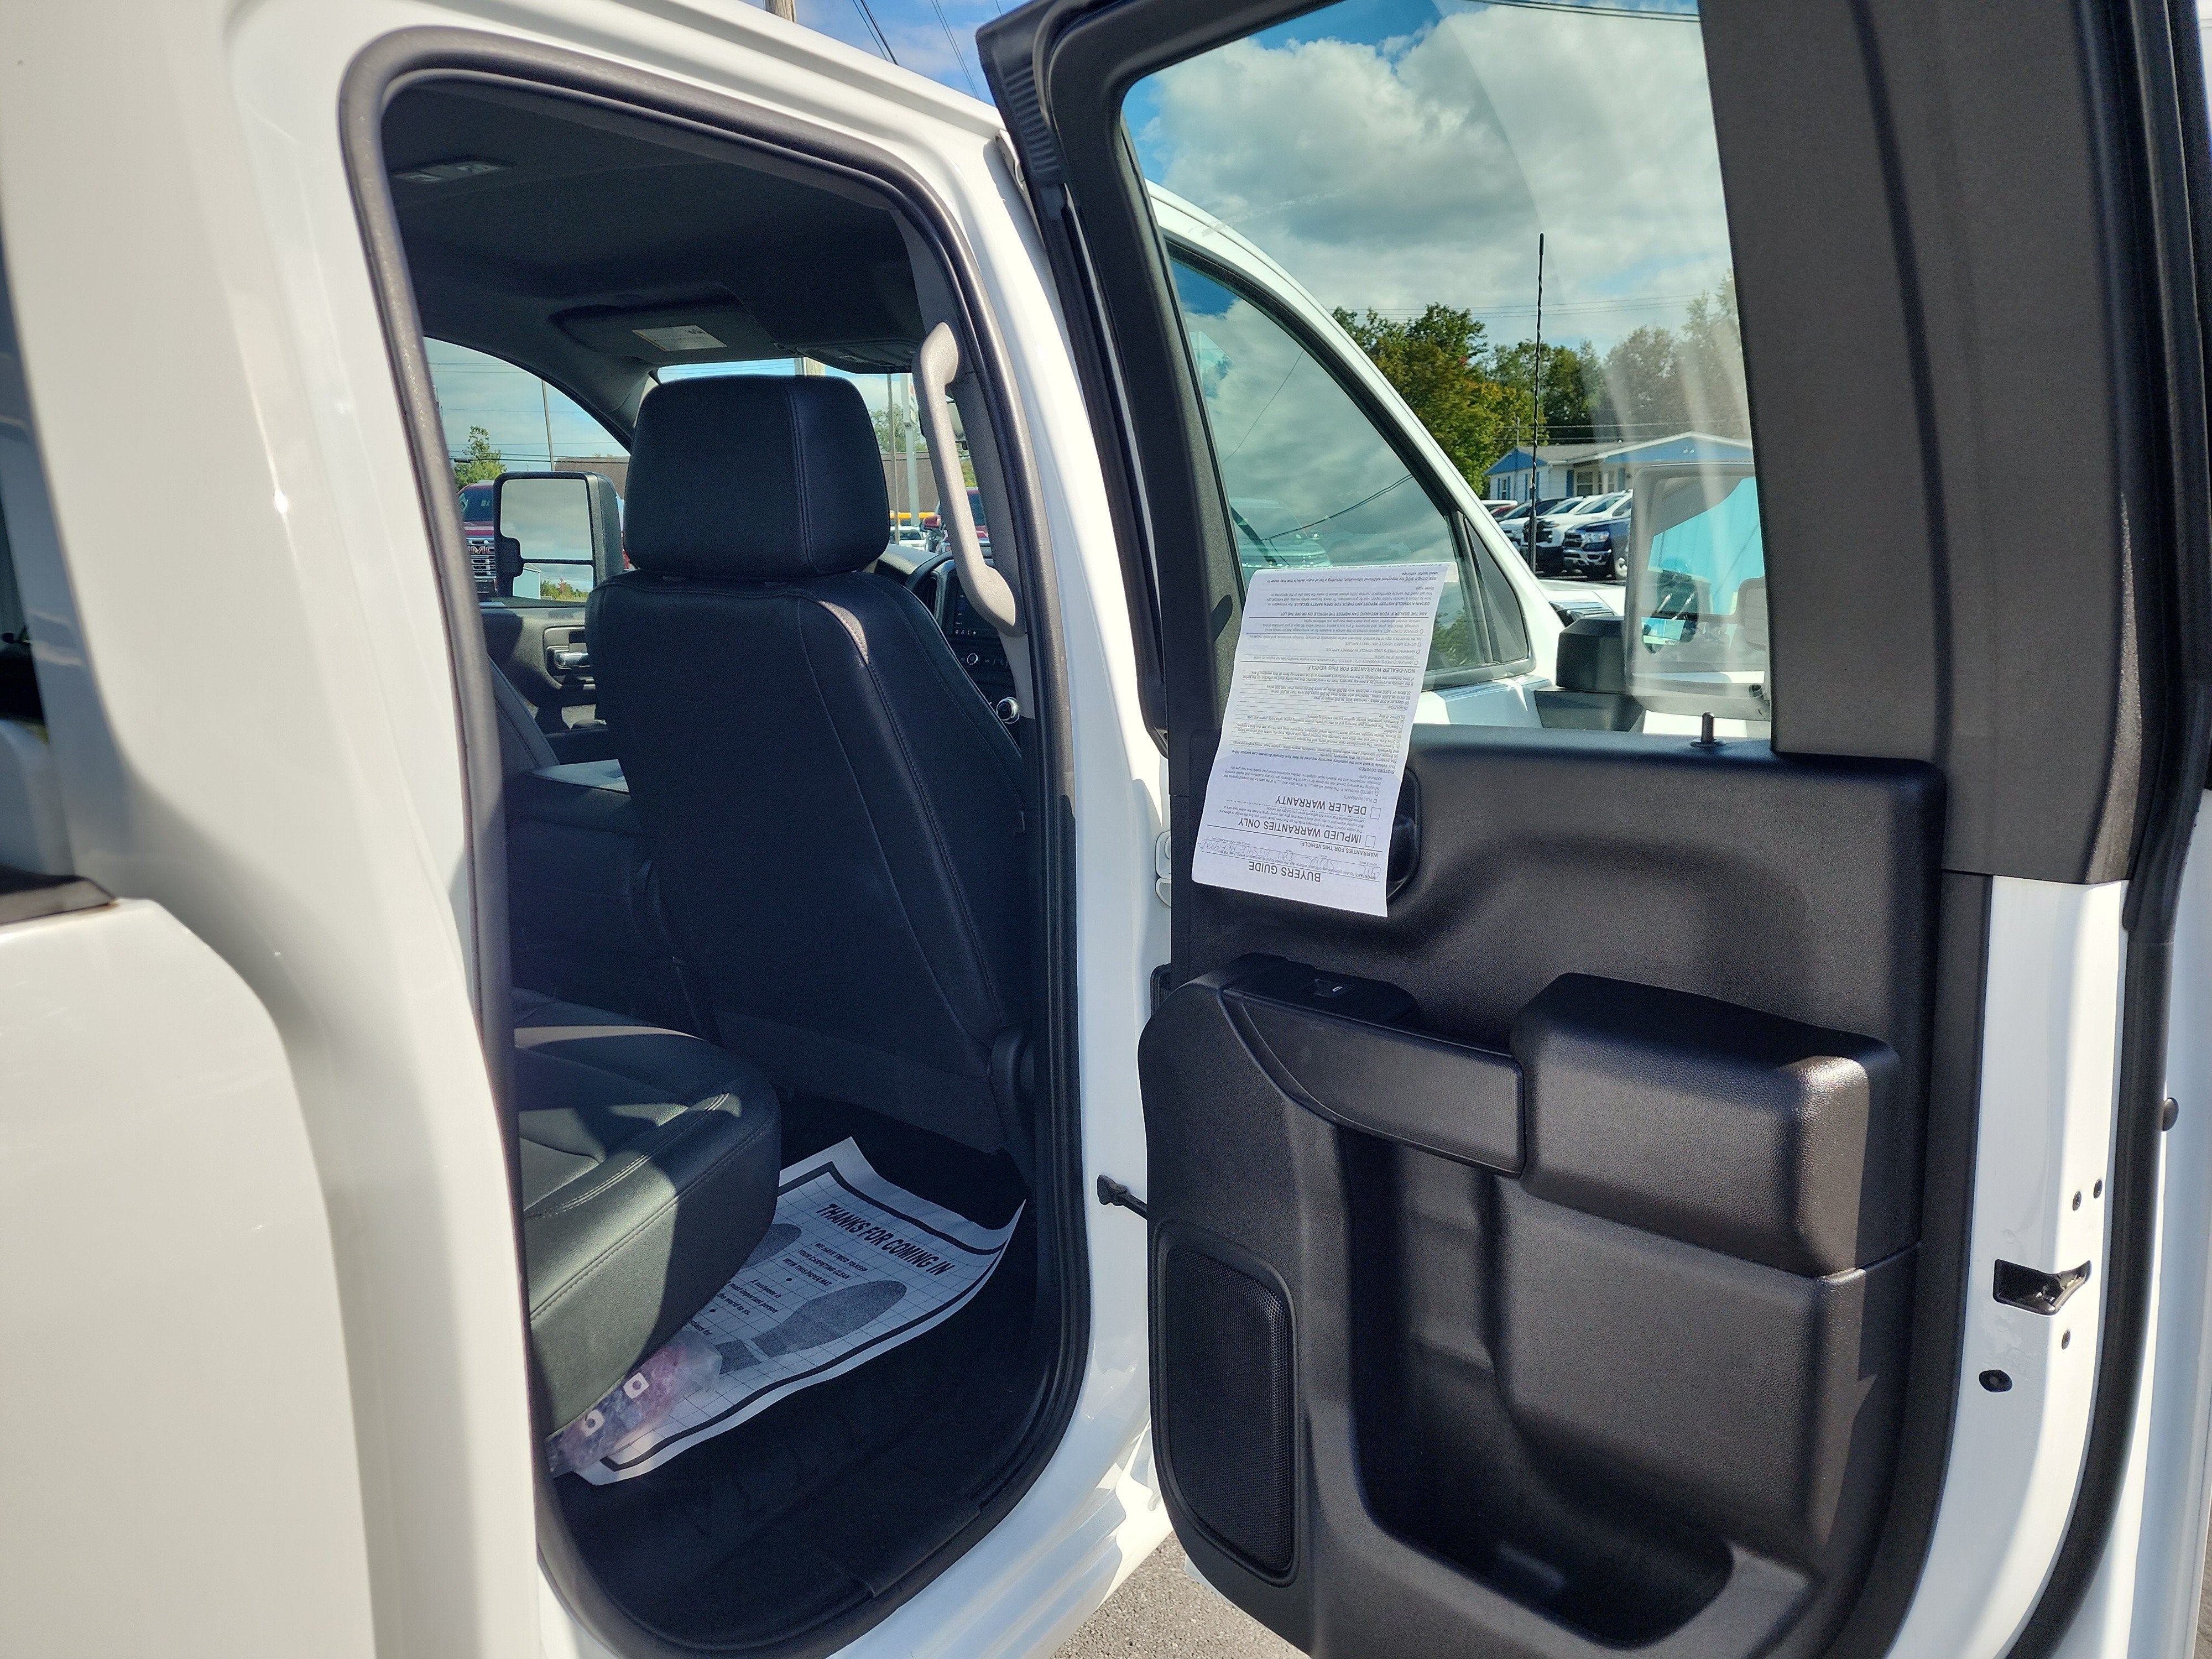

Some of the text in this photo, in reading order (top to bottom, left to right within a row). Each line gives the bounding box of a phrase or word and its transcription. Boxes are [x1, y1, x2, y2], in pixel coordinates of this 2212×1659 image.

[468, 546, 495, 554] MC
[1275, 795, 1366, 815] DEALER WARRANTY
[1238, 817, 1361, 843] IMPLIED WARRANTIES ONLY
[1345, 848, 1378, 857] WARRANTIES
[1248, 860, 1321, 882] BUYERS GUIDE
[816, 1203, 956, 1276] THANKS FOR COMING IN
[798, 1249, 852, 1280] YOUR CARPETING CLEAN
[822, 1248, 837, 1256] HAVE
[834, 1254, 849, 1262] TRIED
[782, 1258, 798, 1267] WITH
[795, 1265, 808, 1275] THIS
[804, 1271, 823, 1281] PAPER
[728, 1283, 779, 1313] most important person
[754, 1282, 778, 1295] customer
[724, 1298, 742, 1307] world
